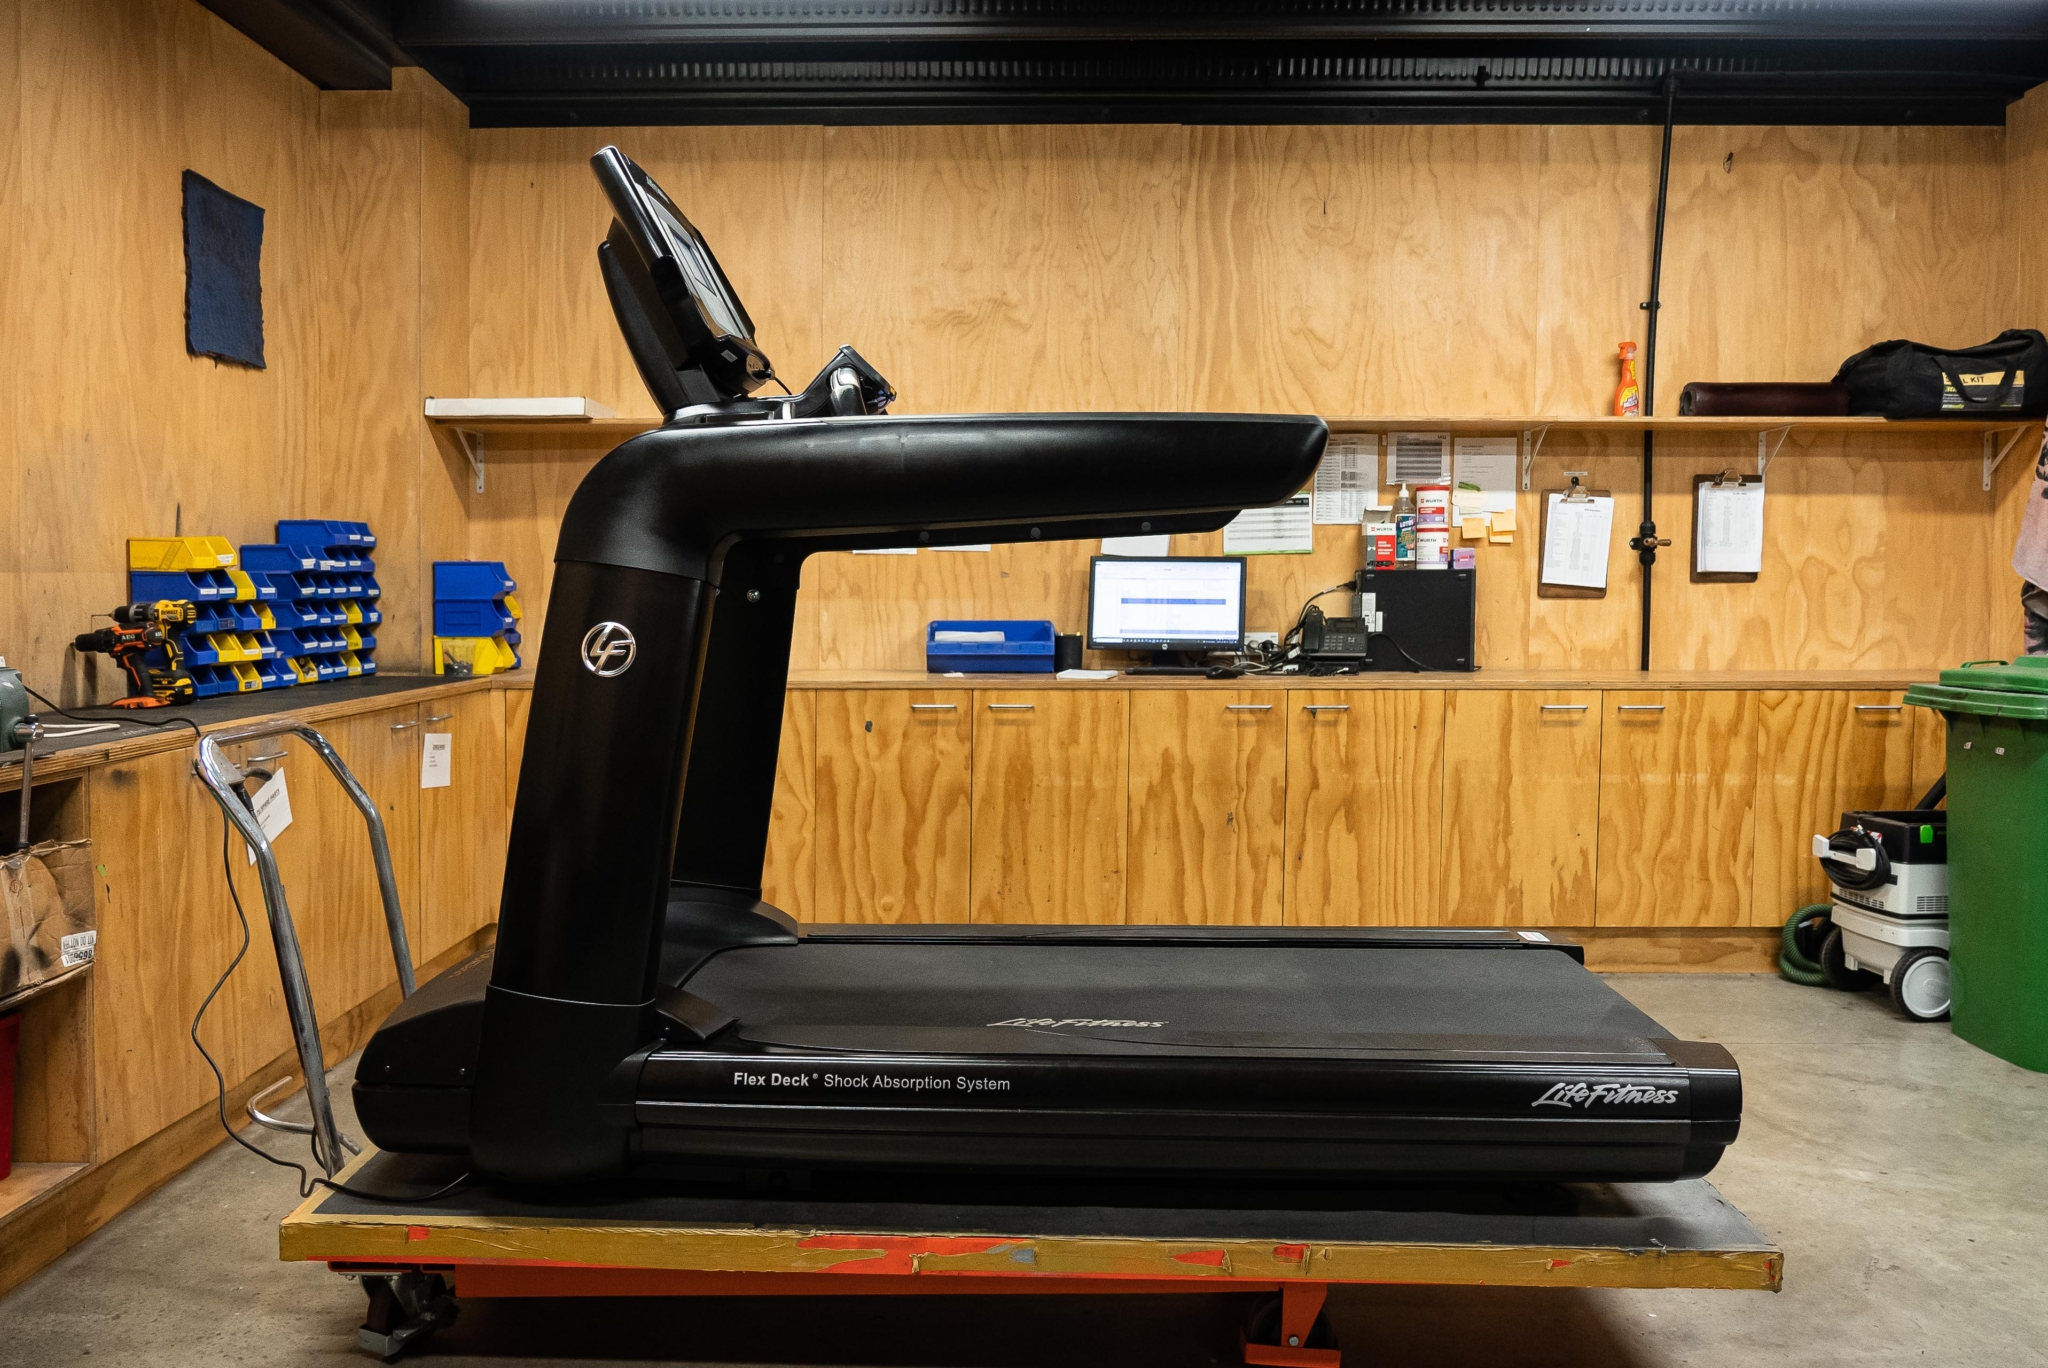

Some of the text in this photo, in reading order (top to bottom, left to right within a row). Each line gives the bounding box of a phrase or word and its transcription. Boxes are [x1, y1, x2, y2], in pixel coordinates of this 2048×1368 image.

[1970, 376, 1985, 384] KIT
[734, 1072, 765, 1087] Flex
[824, 1074, 869, 1088] Shock
[873, 1075, 951, 1091] Absorption
[956, 1076, 1011, 1092] System
